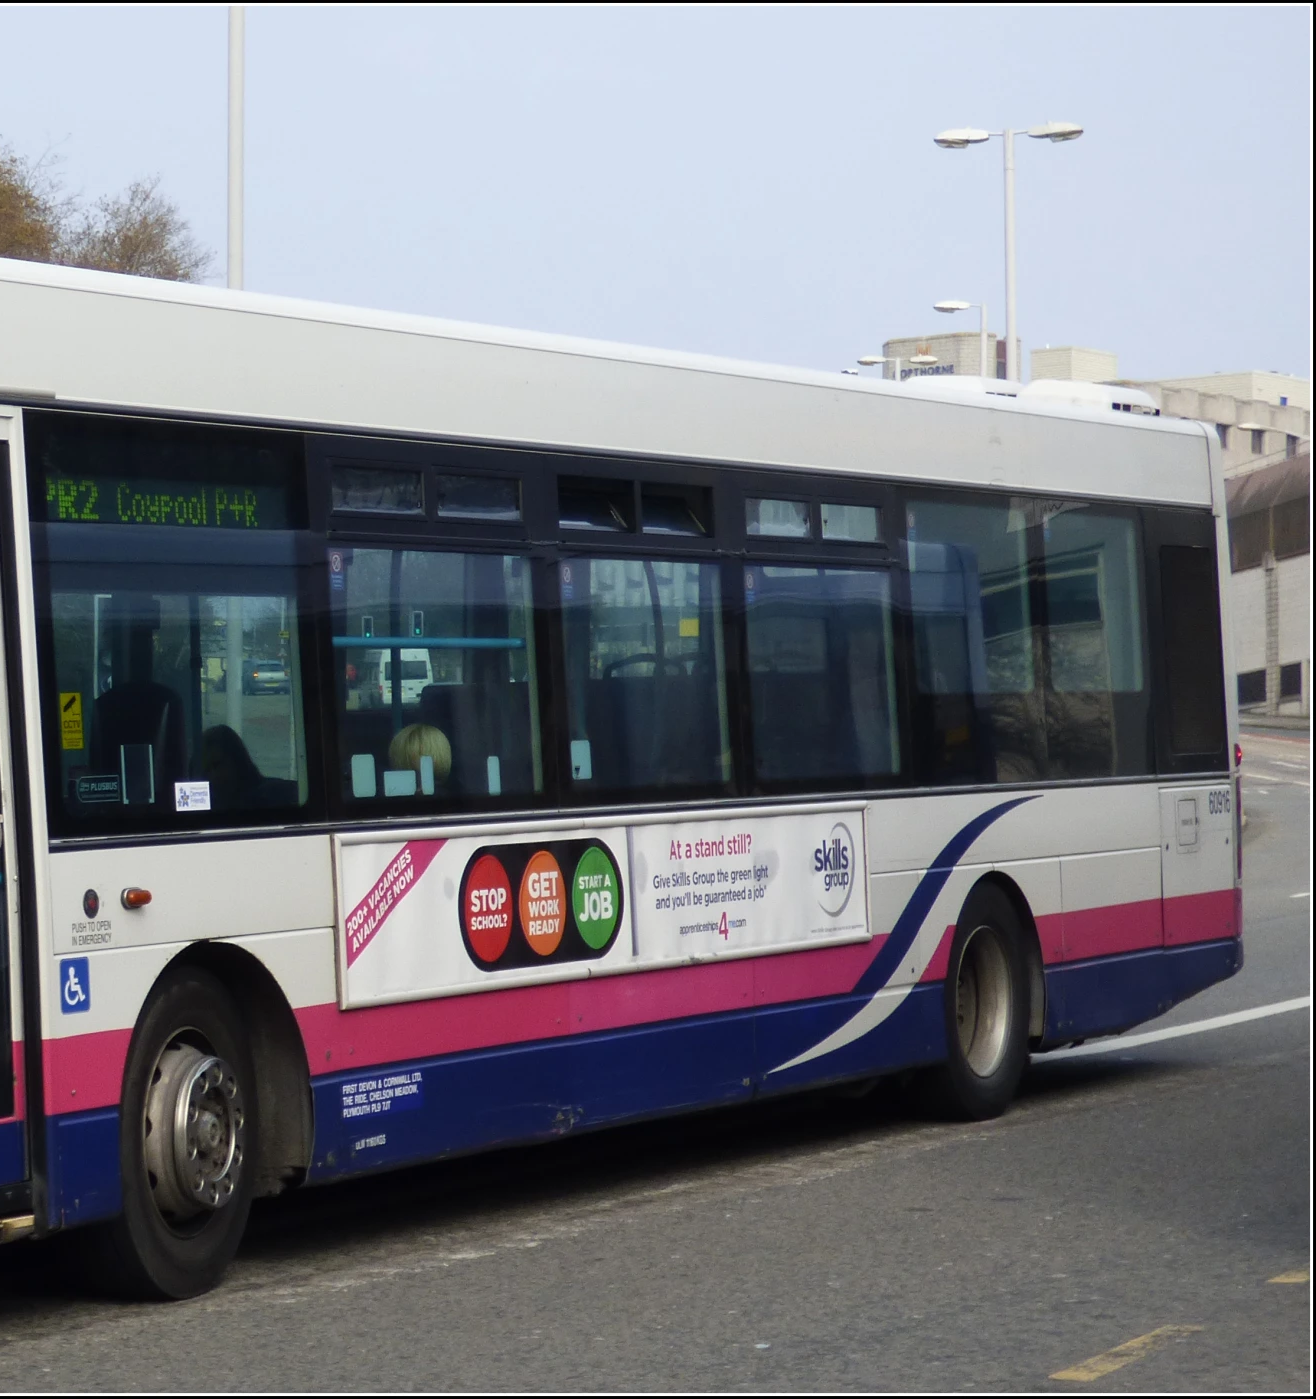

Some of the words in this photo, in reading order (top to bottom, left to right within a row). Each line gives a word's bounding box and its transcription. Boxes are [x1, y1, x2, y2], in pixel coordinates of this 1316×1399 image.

[892, 364, 955, 381] OPTHORNE
[117, 482, 207, 525] Coypool
[216, 488, 258, 527] P+R
[63, 720, 81, 729] CCTV
[91, 782, 118, 791] PLUSBUS
[1209, 790, 1231, 815] 60916
[669, 839, 682, 860] At
[685, 842, 692, 859] a
[695, 835, 725, 859] stand
[727, 833, 752, 856] still?
[814, 838, 849, 872] skills
[528, 871, 559, 899] GET
[578, 875, 603, 889] START
[603, 873, 611, 887] A
[653, 873, 671, 889] Give
[671, 871, 691, 888] Skills
[692, 871, 716, 886] Group
[717, 868, 729, 883] the
[730, 868, 752, 885] green
[753, 864, 769, 882] light
[824, 872, 849, 892] group
[347, 906, 368, 938] 200+
[368, 849, 412, 910] VACANCIES
[470, 887, 507, 912] STOP
[655, 895, 671, 909] and
[672, 891, 692, 911] you'll
[692, 890, 703, 906] be
[704, 887, 746, 908] guaranteed
[747, 888, 752, 900] a
[352, 892, 393, 952] AVAILABLE
[392, 864, 414, 898] NOW
[528, 899, 560, 918] WORK
[579, 890, 613, 922] JOB
[71, 922, 87, 934] PUSH
[87, 922, 96, 932] TO
[96, 920, 112, 931] OPEN
[471, 913, 508, 930] SCHOOL?
[529, 919, 560, 936] READY
[71, 936, 78, 946] IN
[78, 933, 112, 946] EMERGENCY
[342, 1083, 358, 1095] FIRST
[358, 1080, 377, 1092] DEVON
[377, 1079, 382, 1089] &
[383, 1074, 411, 1088] CORNWALL
[342, 1096, 354, 1106] THE
[369, 1088, 394, 1102] CHELSON
[342, 1104, 371, 1118] PLYMOUTH
[371, 1102, 382, 1113] PL9
